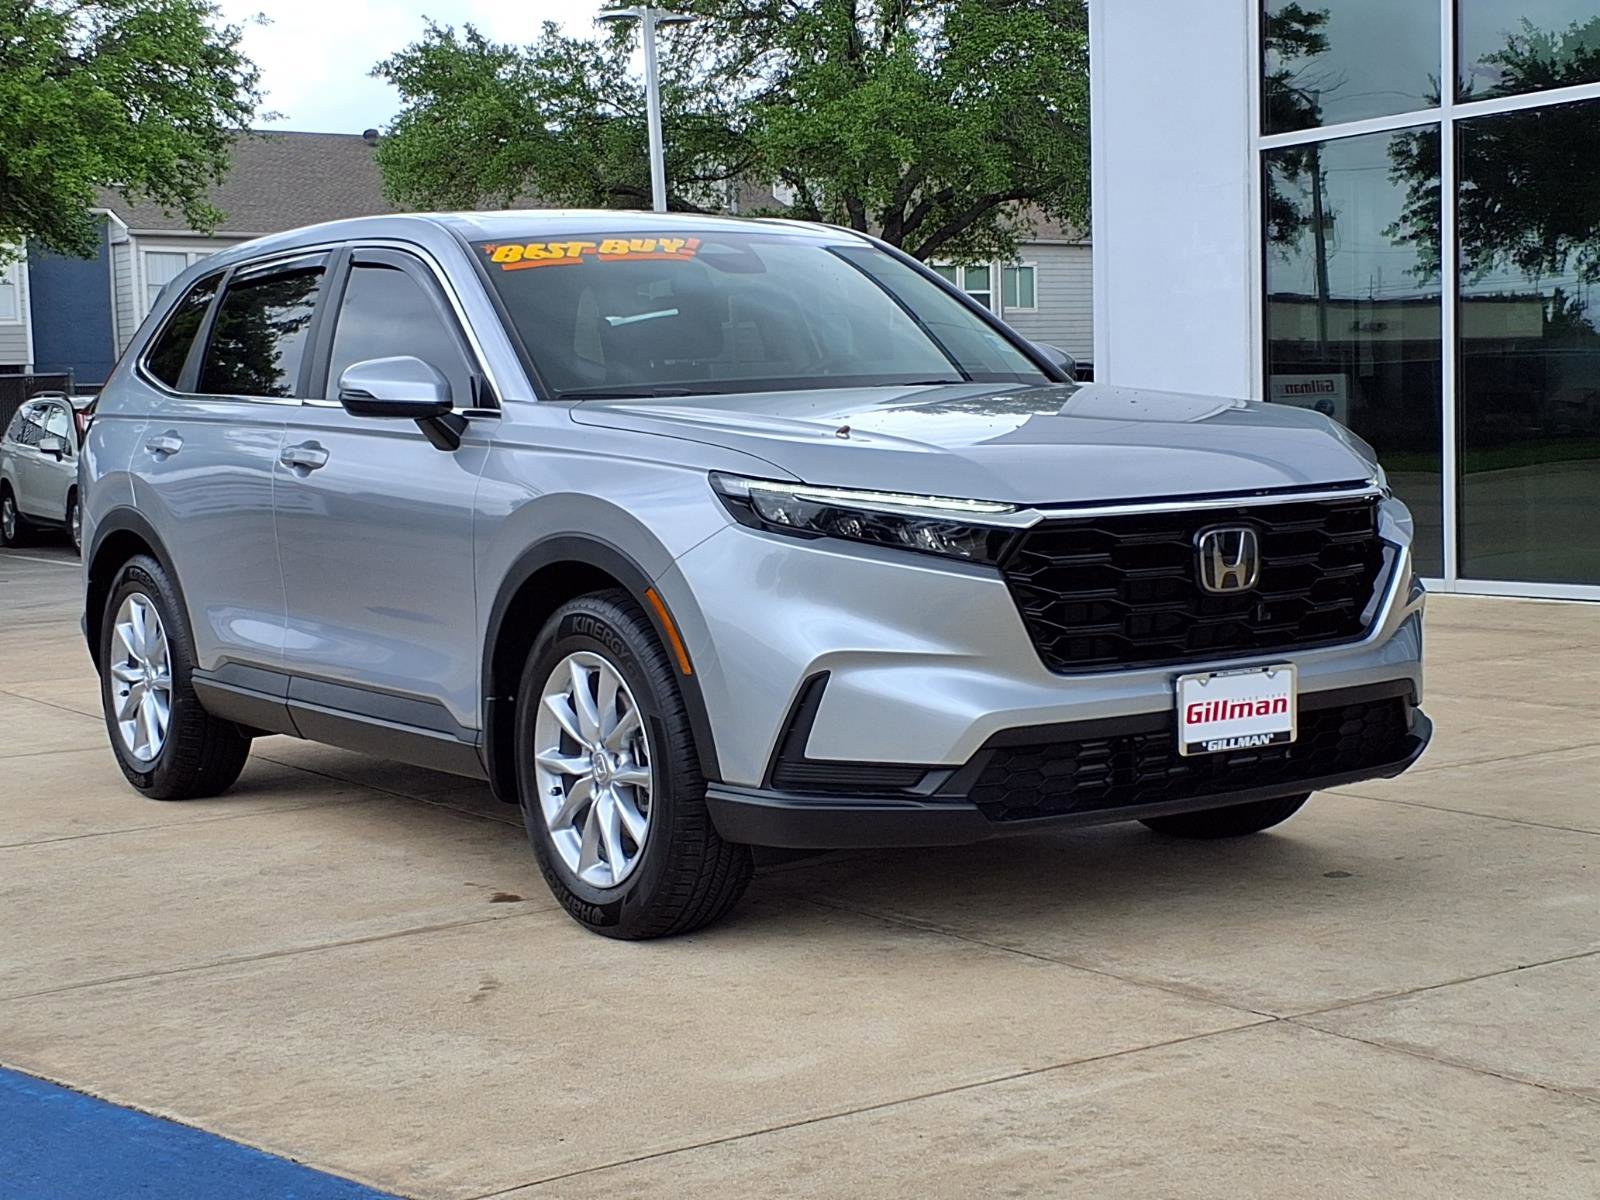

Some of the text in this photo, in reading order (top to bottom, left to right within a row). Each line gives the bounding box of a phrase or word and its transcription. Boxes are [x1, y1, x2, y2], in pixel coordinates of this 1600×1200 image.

[491, 241, 596, 263] BEST
[572, 616, 630, 661] KINERGY
[1186, 697, 1288, 725] Gillman
